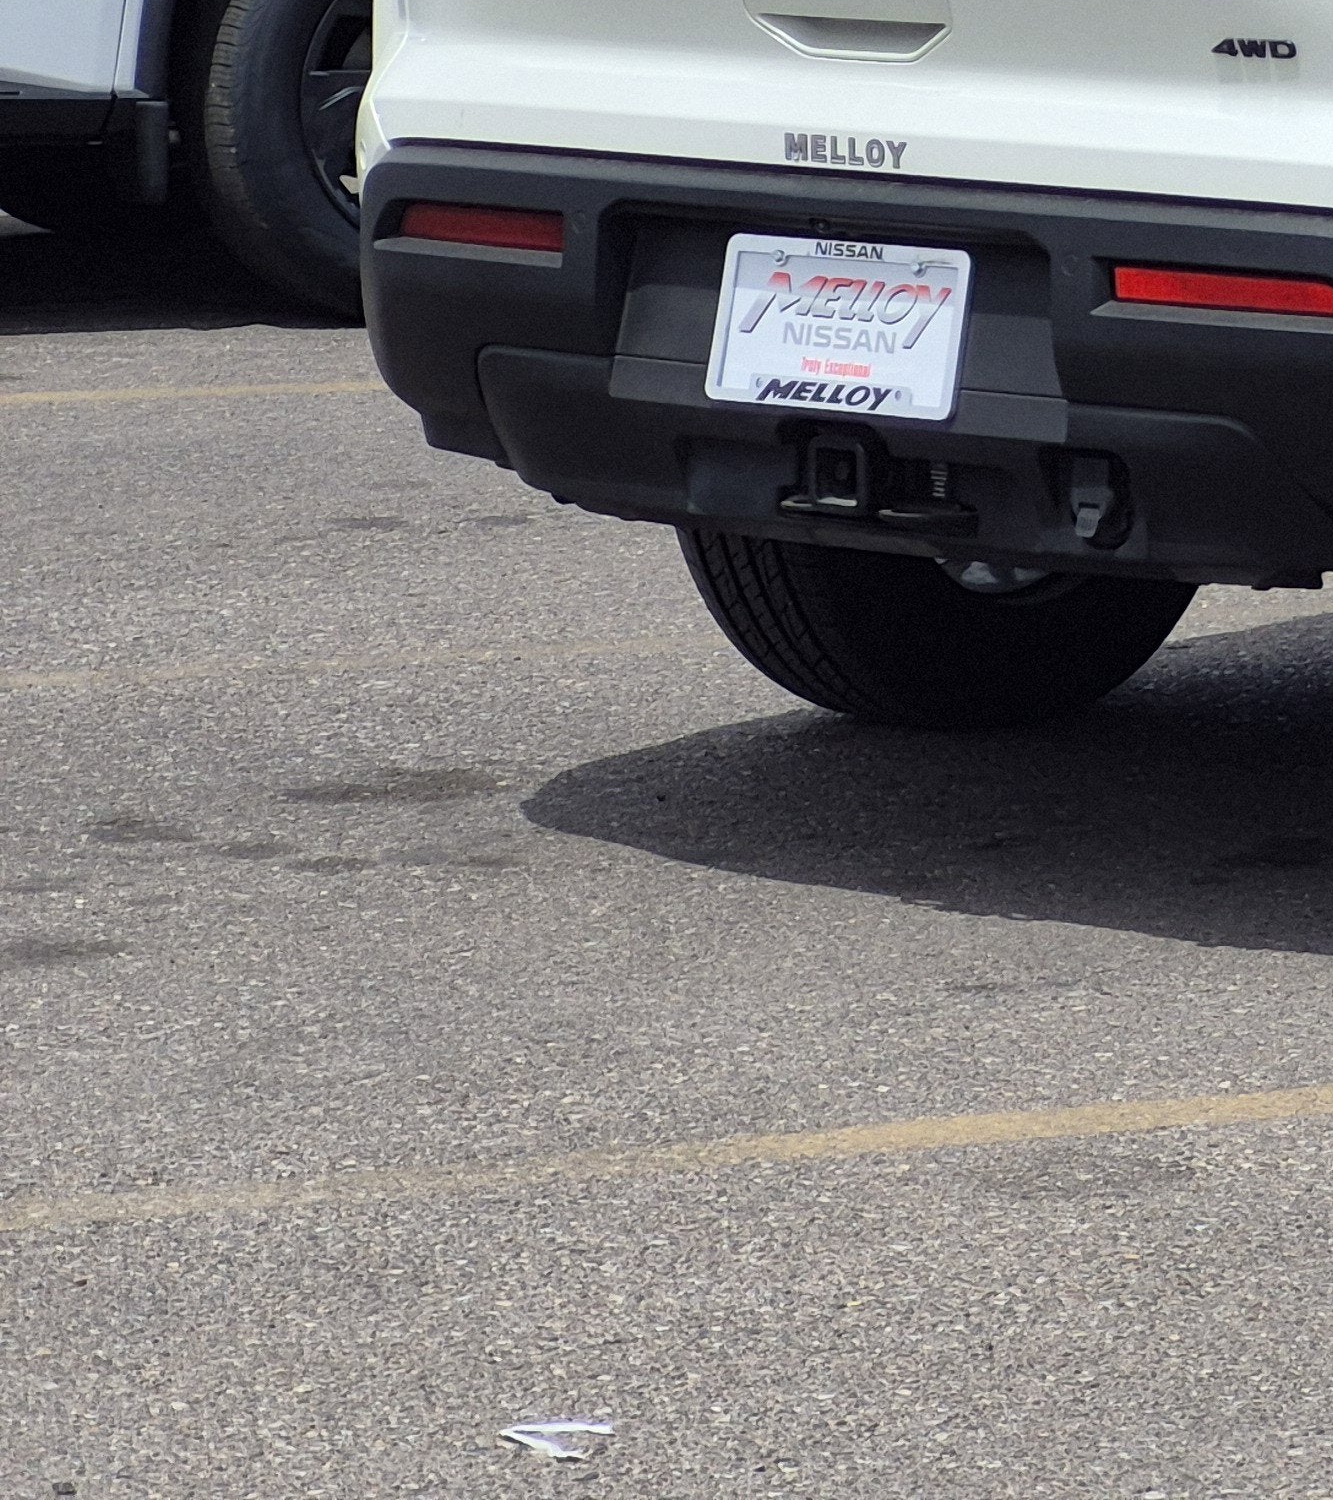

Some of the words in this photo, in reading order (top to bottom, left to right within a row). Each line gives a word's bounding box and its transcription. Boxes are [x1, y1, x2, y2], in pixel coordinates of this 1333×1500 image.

[1211, 38, 1297, 60] 4WD
[783, 131, 908, 170] MELLOY
[814, 241, 884, 260] NISSAN
[739, 271, 952, 350] MELLOY
[782, 321, 897, 355] NISSAN
[755, 378, 894, 411] MELLOY
